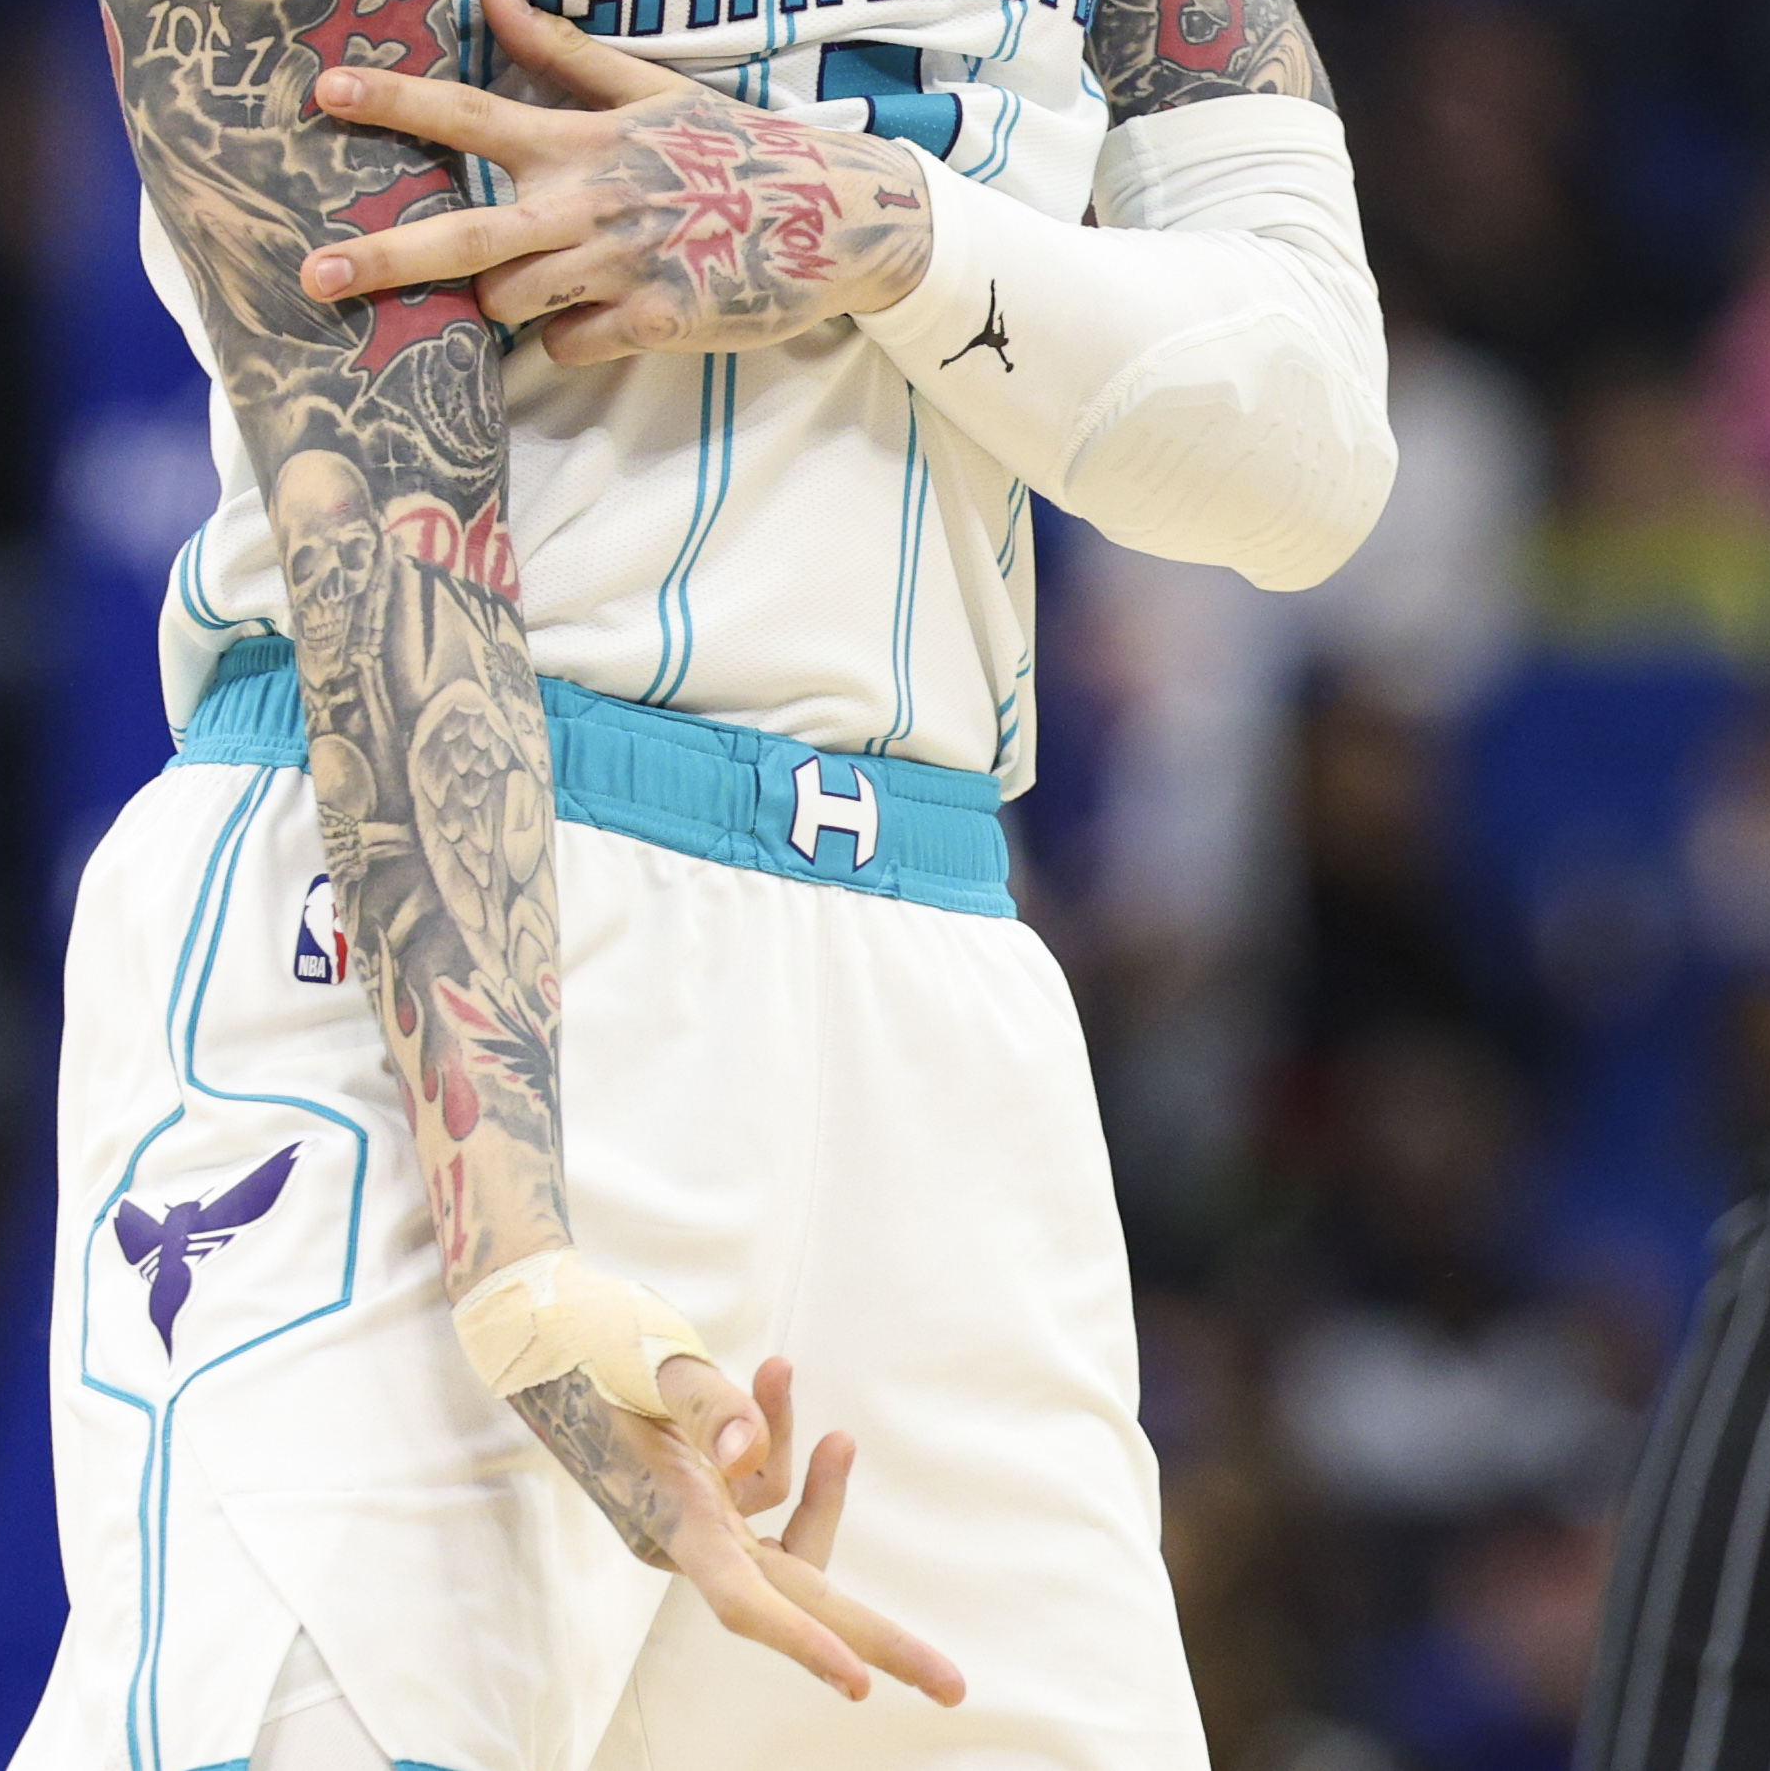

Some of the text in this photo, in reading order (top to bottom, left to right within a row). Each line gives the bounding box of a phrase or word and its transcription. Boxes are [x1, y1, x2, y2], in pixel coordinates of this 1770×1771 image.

[645, 123, 753, 297] HERE
[756, 181, 843, 283] FROM
[786, 754, 881, 874] H
[297, 954, 327, 979] NBA
